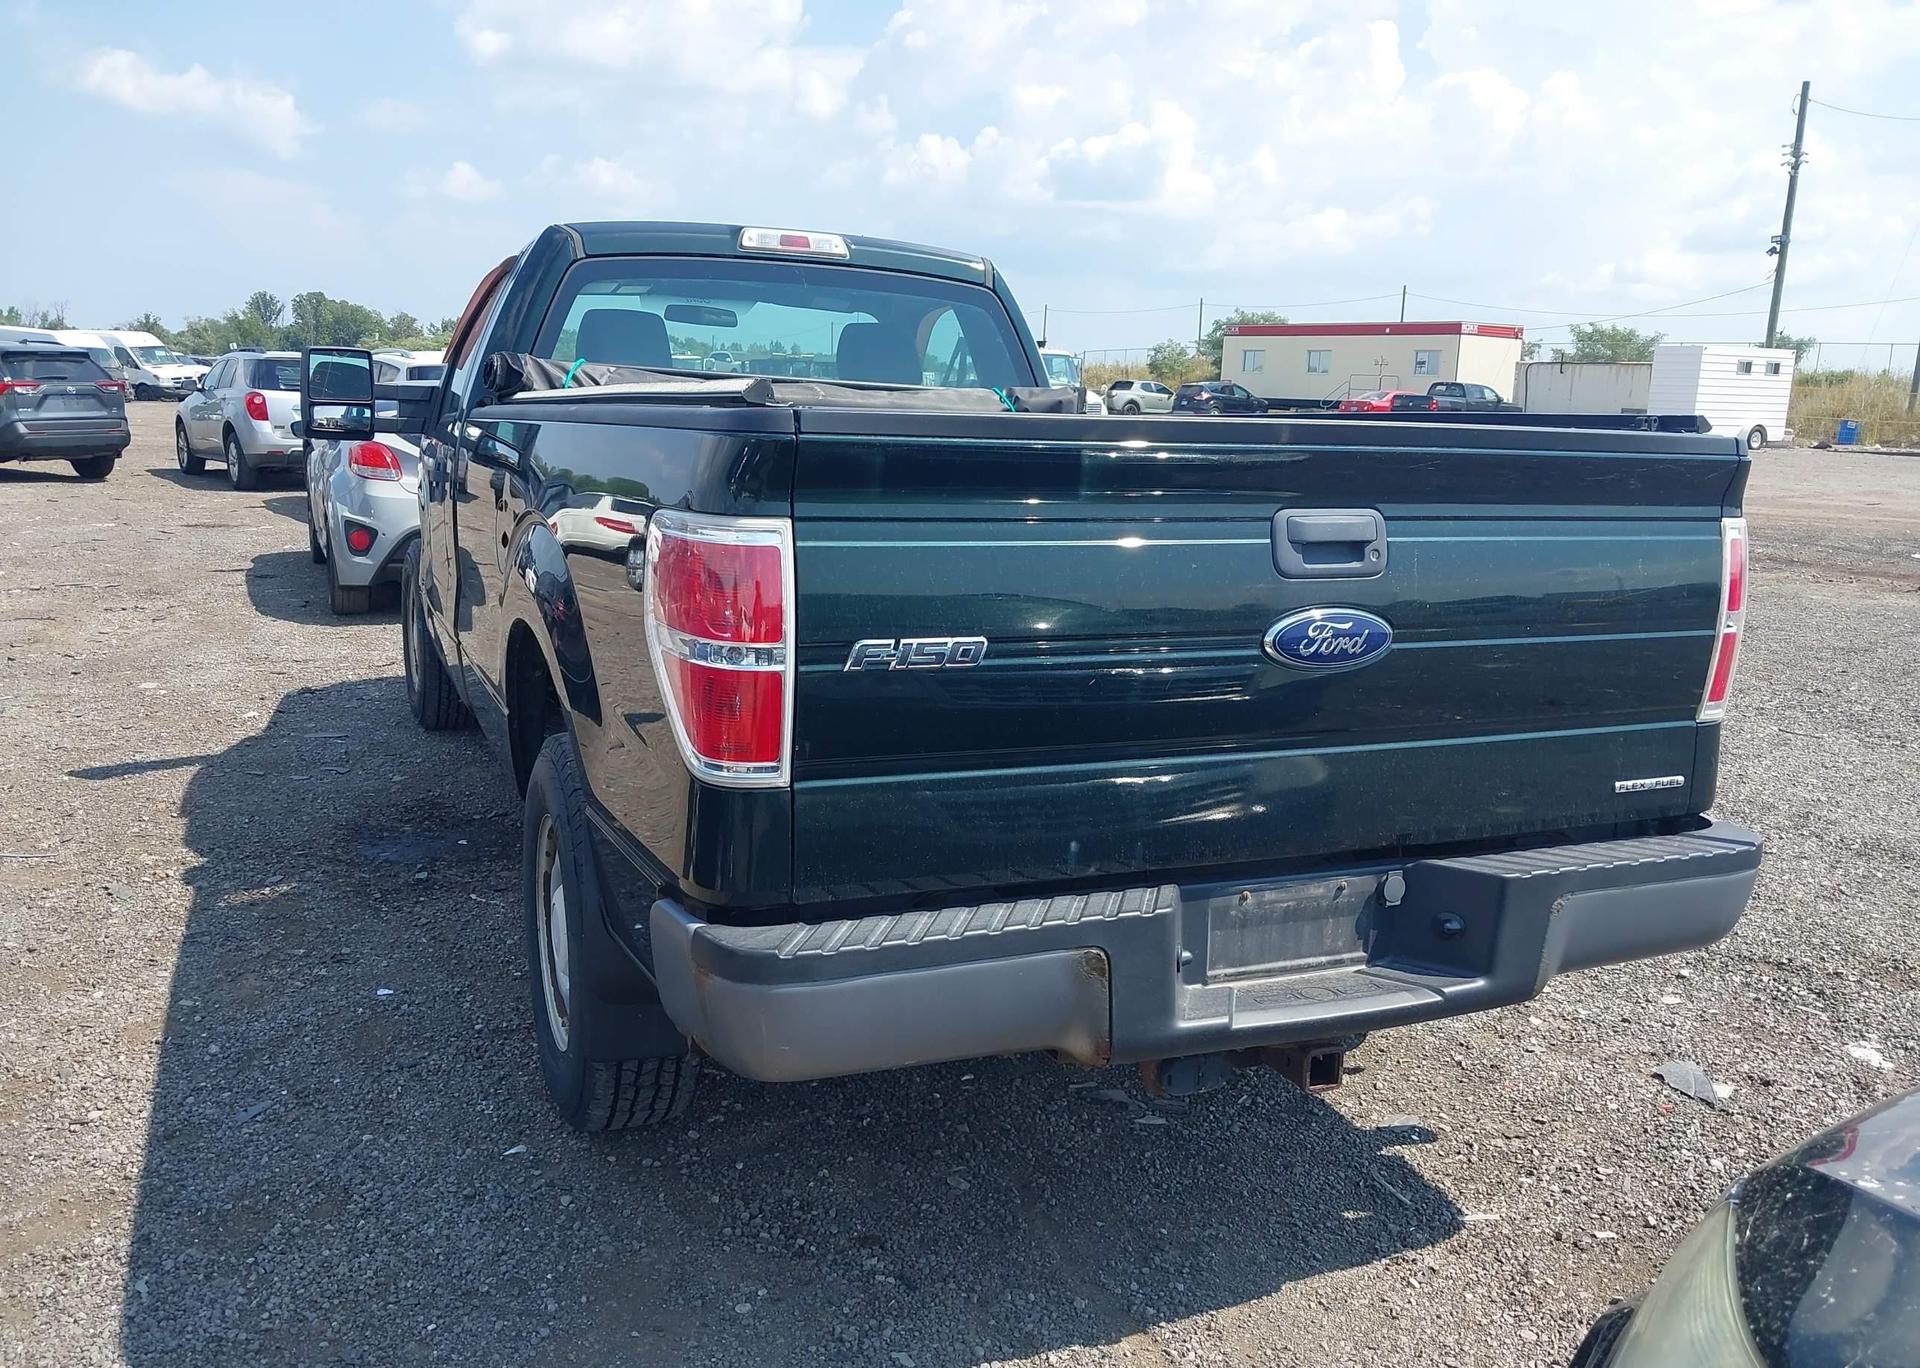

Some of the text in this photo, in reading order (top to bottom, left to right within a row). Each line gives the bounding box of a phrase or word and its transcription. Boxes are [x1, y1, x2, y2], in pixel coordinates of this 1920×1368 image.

[843, 636, 988, 671] F-150
[1300, 621, 1369, 656] Ford
[1618, 779, 1682, 791] FLEX FUEL
